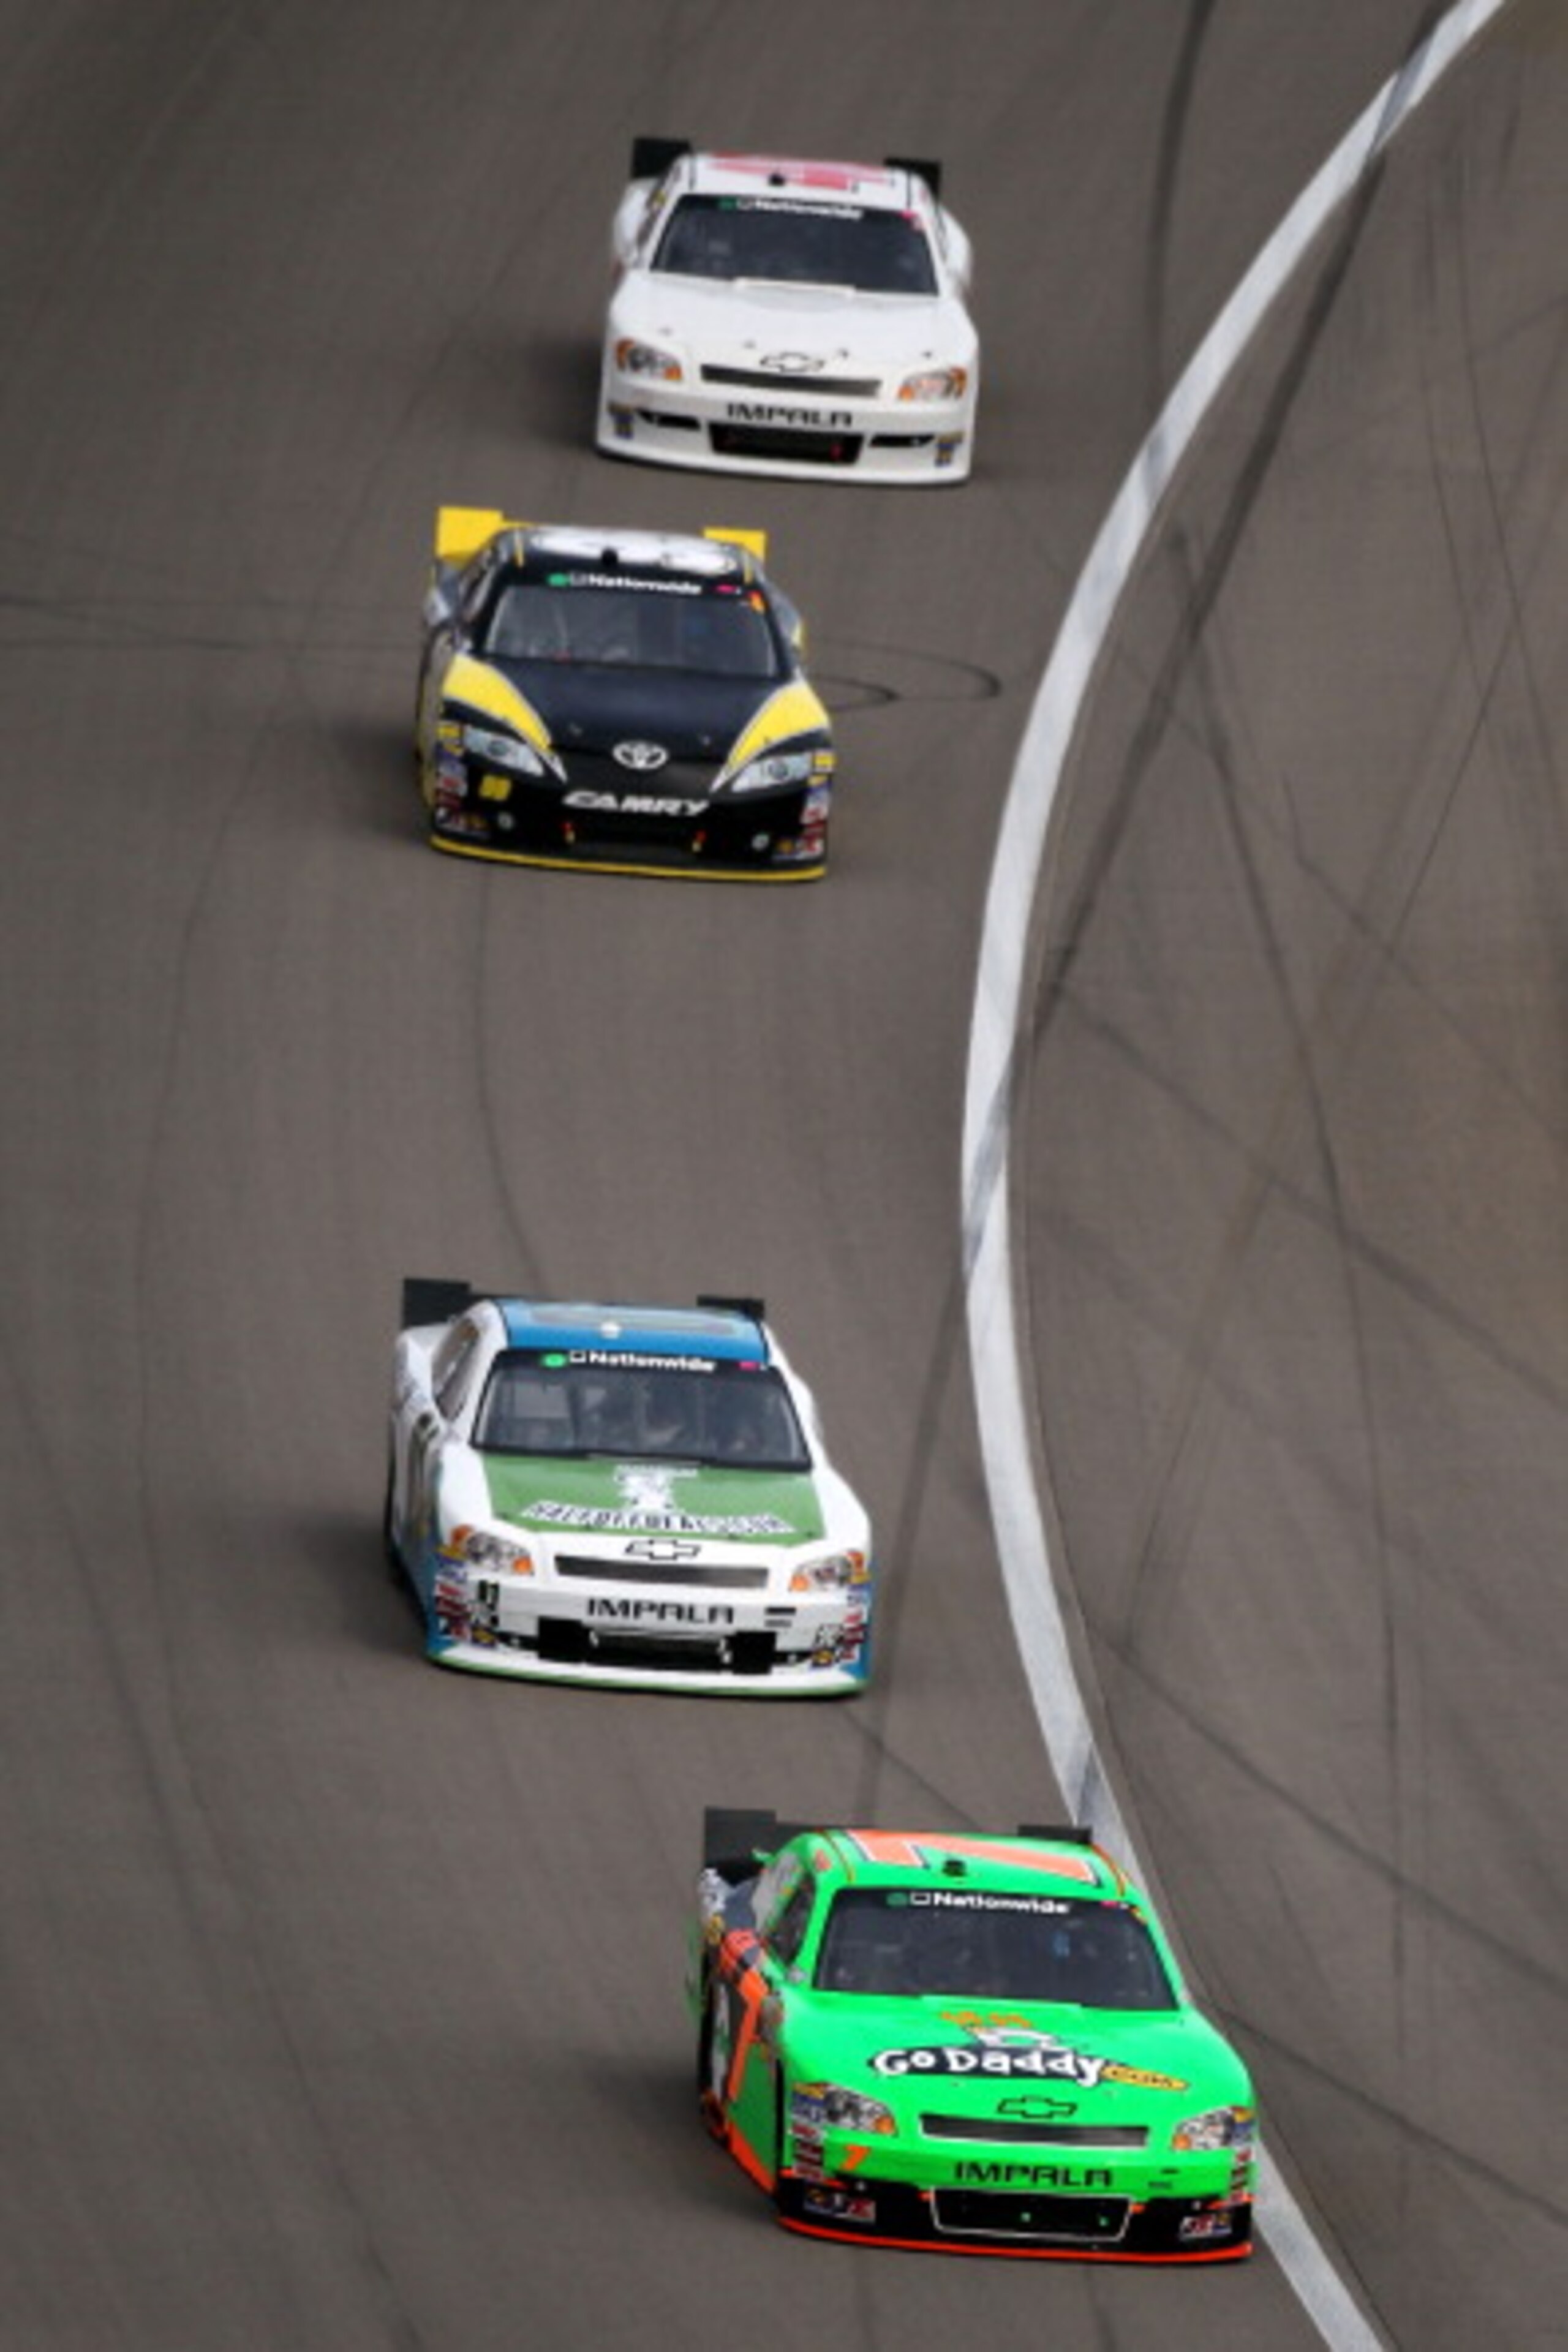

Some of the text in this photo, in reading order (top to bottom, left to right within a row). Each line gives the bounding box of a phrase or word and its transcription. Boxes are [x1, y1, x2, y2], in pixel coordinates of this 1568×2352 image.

[727, 402, 853, 428] IMPALA
[588, 573, 702, 595] Nationwide
[563, 791, 709, 816] CAMRY
[589, 1350, 715, 1371] Nationwide
[588, 1598, 734, 1624] IMPALA
[933, 1891, 1071, 1915] Nationwide
[873, 2049, 936, 2075] Go
[943, 2046, 1105, 2087] Daddy
[840, 2144, 871, 2170] 7
[956, 2162, 1112, 2187] IMPALA
